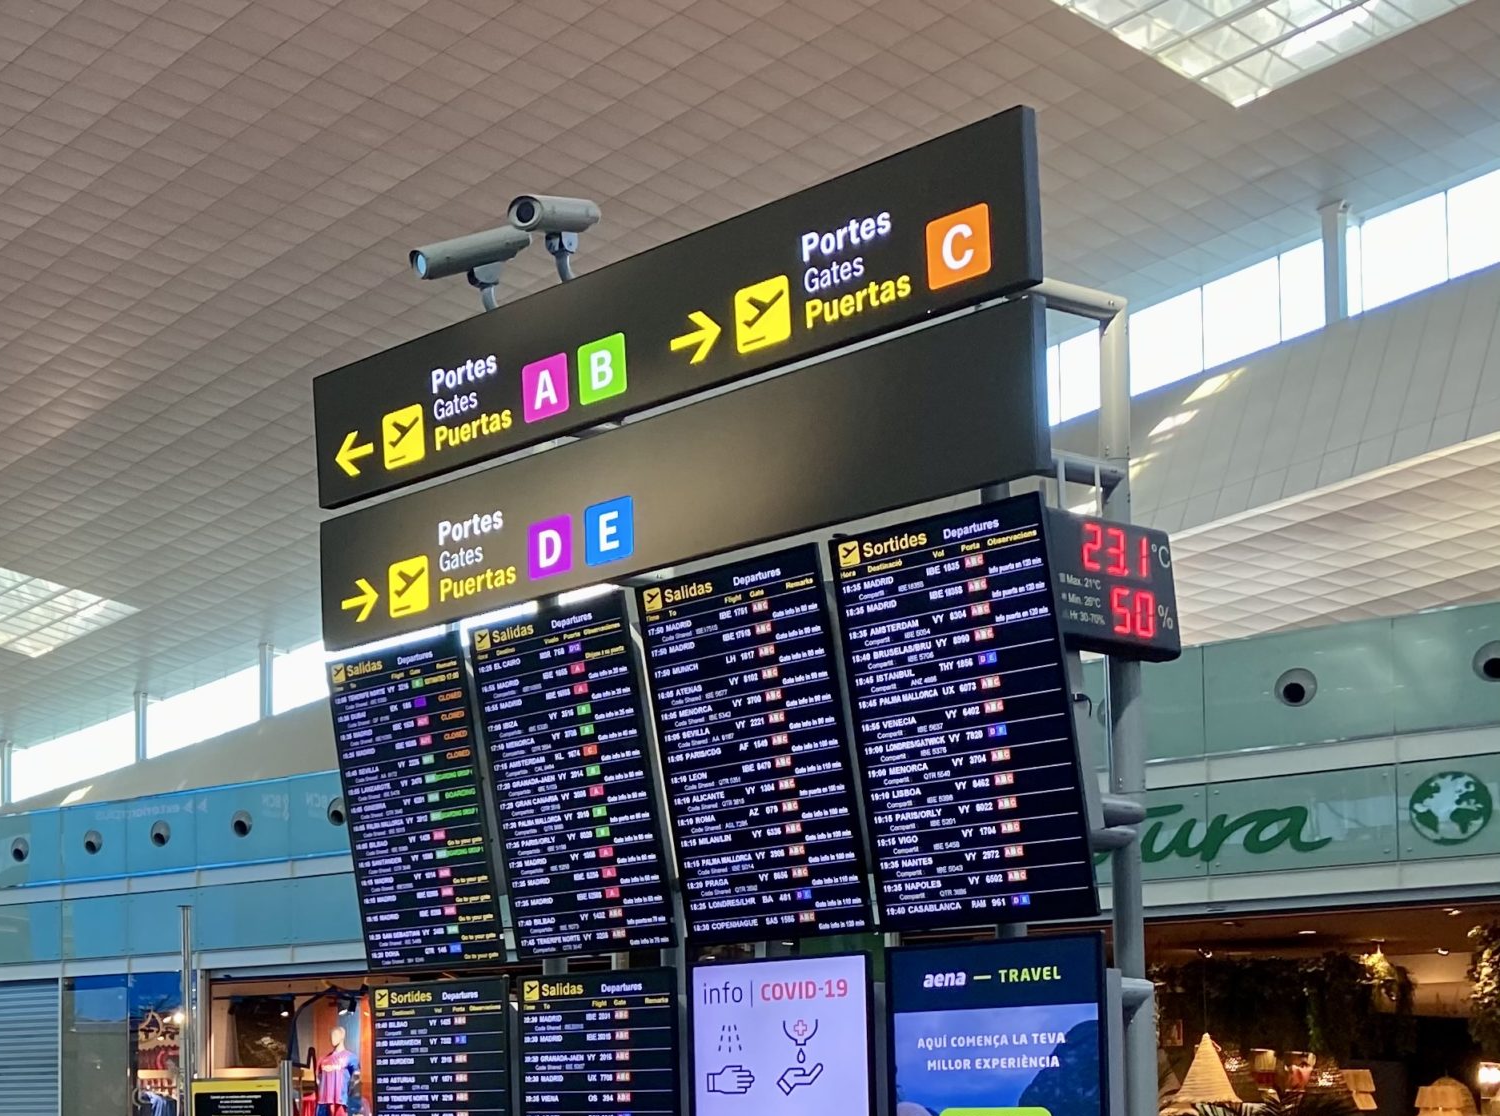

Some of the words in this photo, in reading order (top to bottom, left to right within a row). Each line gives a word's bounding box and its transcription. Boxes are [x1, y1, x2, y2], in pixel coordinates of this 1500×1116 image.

[801, 211, 892, 263] Portes
[804, 256, 865, 293] Gates
[942, 223, 974, 270] C
[805, 274, 912, 328] Puertas
[431, 354, 497, 394] Portes
[433, 392, 478, 421] Gates
[534, 369, 558, 410] A
[590, 349, 613, 391] B
[434, 409, 513, 451] Puertas
[438, 510, 504, 546] Portes
[439, 546, 484, 572] Gates
[538, 529, 562, 568] D
[599, 511, 620, 552] E
[861, 529, 928, 558] Sortides
[942, 516, 999, 541] Departures
[840, 568, 856, 578] Hora
[932, 549, 944, 558] Vol
[960, 541, 980, 552] Porta
[986, 528, 1037, 546] Observacions
[440, 565, 517, 602] Puertas
[663, 579, 713, 603] Salidas
[732, 567, 781, 587] Departures
[863, 575, 893, 589] MADRID
[1066, 573, 1082, 586] Max.
[1084, 577, 1101, 590] 21°C
[866, 599, 897, 612] MADRID
[1068, 592, 1082, 605] Min.
[1111, 586, 1156, 638] 50
[491, 622, 534, 643] Salidas
[550, 611, 592, 630] Departures
[665, 620, 692, 632] MADRID
[869, 619, 919, 636] AMSTERDAM
[668, 641, 695, 653] MADRID
[346, 657, 383, 677] Salidas
[396, 649, 433, 667] Departures
[875, 668, 915, 682] ISTANBUL
[675, 684, 702, 696] ATENAS
[901, 688, 938, 702] MALLORCA
[678, 705, 712, 717] MENORCA
[882, 716, 916, 729] VENECIA
[681, 727, 710, 739] SEVILLA
[888, 762, 928, 775] MENORCA
[691, 791, 725, 802] ALICANTE
[891, 787, 921, 798] LISBOA
[694, 814, 716, 824] ROMA
[895, 808, 942, 821] PARIS/ORLY
[898, 835, 918, 844] VIGO
[901, 857, 933, 867] NANTES
[704, 878, 729, 887] PRAGA
[904, 880, 941, 890] NAPOLES
[907, 902, 961, 913] CASABLANCA
[710, 918, 758, 929] COPENHAGUE
[923, 971, 967, 988] aena
[998, 966, 1062, 983] TRAVEL
[541, 981, 583, 996] Salidas
[601, 981, 642, 993] Departures
[703, 981, 743, 1005] info
[761, 979, 848, 1001] COVID-19
[390, 990, 432, 1003] Sortides
[441, 990, 478, 1001] Departures
[917, 1034, 947, 1050] AQUÍ
[950, 1034, 1009, 1048] COMENÇA
[1012, 1034, 1028, 1046] LA
[1031, 1032, 1066, 1044] TEVA
[927, 1058, 971, 1071] MILLOR
[975, 1053, 1060, 1069] EXPERIÈNCIA
